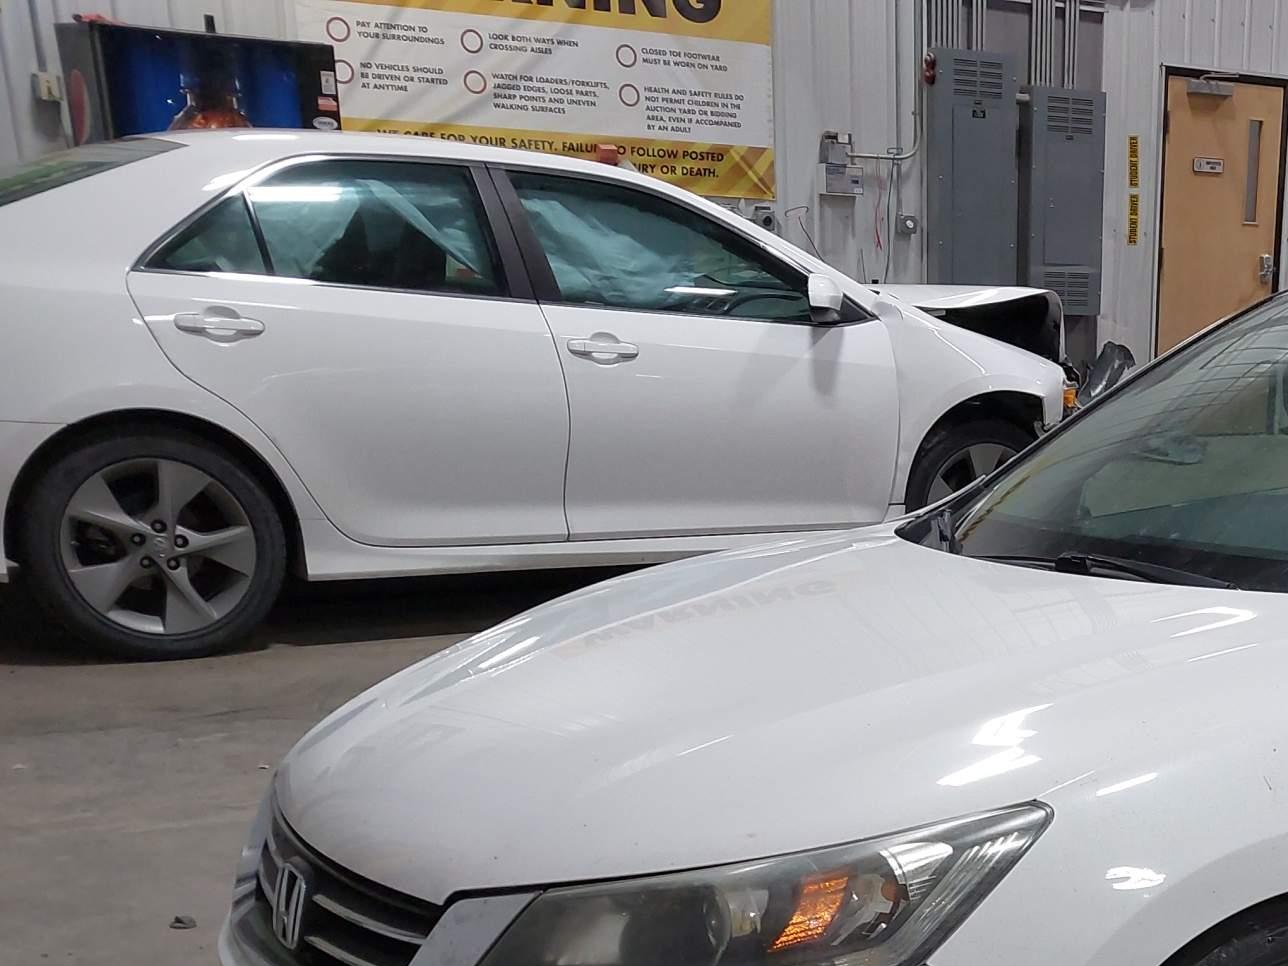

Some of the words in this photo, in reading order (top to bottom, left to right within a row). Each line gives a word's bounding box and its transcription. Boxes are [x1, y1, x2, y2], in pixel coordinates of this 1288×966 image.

[356, 20, 370, 28] PAY
[374, 21, 415, 32] ATTENTION
[357, 31, 379, 39] YOUR
[382, 33, 445, 45] SURROUNDINGS
[488, 33, 508, 41] LOOK
[512, 34, 532, 43] BOTH
[556, 39, 579, 48] WHEN
[489, 43, 528, 53] CROSSING
[530, 47, 552, 55] AISLES
[641, 48, 667, 57] CLOSED
[669, 50, 681, 58] TOE
[683, 51, 720, 62] FOOTWEAR
[375, 62, 410, 72] VEHICLES
[412, 65, 444, 75] SHOULD
[642, 57, 661, 65] MUST
[673, 60, 696, 69] WORN
[710, 64, 728, 72] YARD
[372, 73, 400, 82] DRIVEN
[403, 75, 415, 83] OR
[417, 76, 448, 85] STARTED
[492, 73, 518, 81] WATCH
[520, 75, 533, 83] FOR
[536, 76, 610, 89] LOADERS/FORKLIFTS,
[373, 83, 409, 92] ANYTIME
[493, 83, 521, 91] JAGGED
[550, 87, 573, 96] LOOSE
[644, 86, 669, 94] HEALTH
[689, 90, 712, 98] SAFETY
[714, 92, 733, 100] RULES
[520, 94, 546, 103] POINTS
[548, 96, 565, 104] AND
[567, 98, 596, 107] UNEVEN
[662, 97, 685, 105] PERMIT
[687, 99, 719, 108] CHILDREN
[493, 102, 529, 112] WALKING
[531, 105, 566, 114] SURFACES
[645, 105, 676, 113] AUCTION
[710, 111, 737, 119] BIDDING
[695, 118, 742, 128] ACCOMPANIED
[470, 135, 507, 148] YOUR
[511, 137, 557, 151] SAFETY.
[562, 141, 597, 153] FAILU
[616, 145, 626, 155] O
[630, 146, 681, 159] FOLLOW
[682, 151, 724, 162] POSTED
[660, 166, 677, 176] OR
[681, 167, 719, 178] DEATH.
